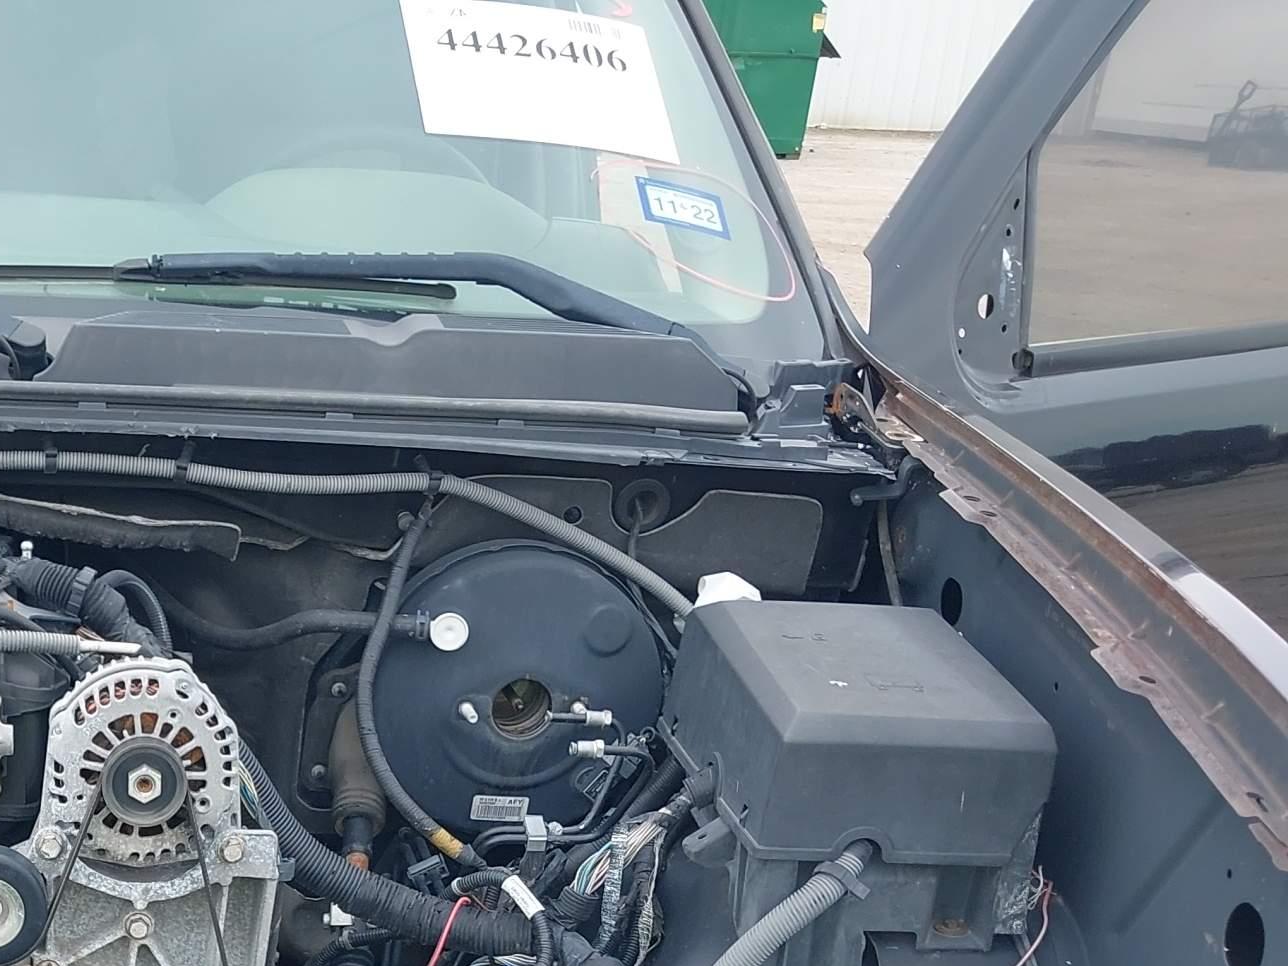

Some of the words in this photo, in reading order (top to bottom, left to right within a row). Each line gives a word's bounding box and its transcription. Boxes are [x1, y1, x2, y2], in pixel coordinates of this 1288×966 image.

[436, 28, 627, 72] 44426406
[653, 197, 678, 214] 11
[690, 204, 718, 225] 22
